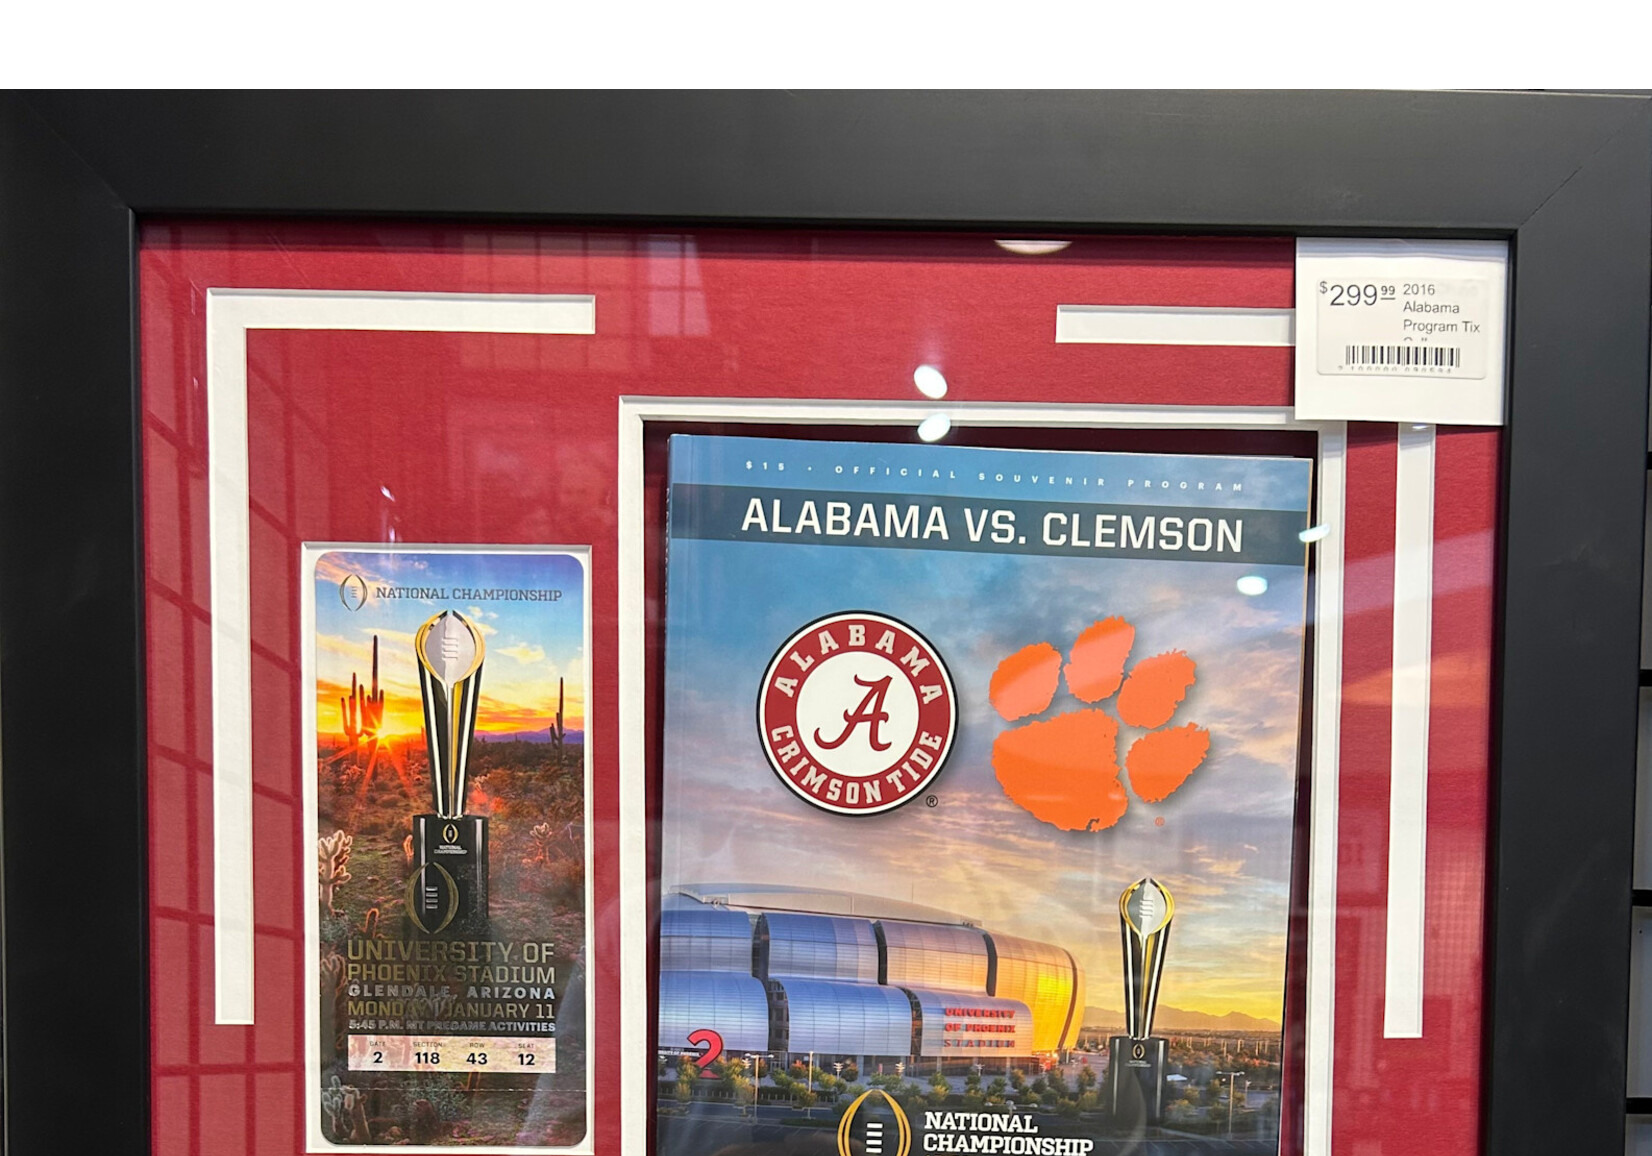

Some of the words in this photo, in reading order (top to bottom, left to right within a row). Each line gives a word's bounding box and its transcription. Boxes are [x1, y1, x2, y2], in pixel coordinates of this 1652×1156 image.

[1403, 284, 1435, 295] 2016
[1403, 301, 1460, 313] Alabama
[1403, 319, 1458, 334] Program
[1462, 321, 1480, 333] Tix
[745, 460, 785, 472] $15
[835, 466, 956, 479] OFFICIAL
[978, 472, 1104, 486] SOUVENIR
[1127, 479, 1243, 491] PROGRAM
[741, 497, 950, 541] ALABAMA
[964, 508, 1026, 545] VS.
[1042, 512, 1243, 553] CLEMSON
[376, 586, 449, 600] NATIONAL
[452, 588, 563, 602] CHAMPIONSHIP
[774, 624, 943, 704] ALABAMA
[772, 725, 883, 805] CRIMSON
[886, 731, 943, 793] TIDE
[348, 939, 514, 963] UNIVERSITY
[523, 942, 555, 963] OF
[348, 963, 446, 982] PHOENIX
[455, 965, 555, 984] STADIUM
[348, 984, 458, 1000] GLENDALE,
[467, 985, 555, 999] ARIZONA
[445, 1002, 530, 1018] JANUARY
[536, 1003, 555, 1018] 11
[945, 1007, 1016, 1019] UNIVERSITY
[349, 1019, 376, 1029] 5:45
[378, 1019, 403, 1030] P.M.
[406, 1020, 425, 1030] MT
[426, 1020, 486, 1031] PREGAME
[488, 1022, 556, 1032] ACTIVITIES
[945, 1023, 961, 1032] OF
[965, 1024, 1016, 1033] PHOENIX
[944, 1039, 1016, 1048] STADIUM
[373, 1051, 383, 1063] 2
[415, 1052, 440, 1064] 118
[466, 1053, 488, 1065] 43
[518, 1053, 535, 1065] 12
[686, 1028, 724, 1079] 2
[924, 1111, 1038, 1133] NATIONAL
